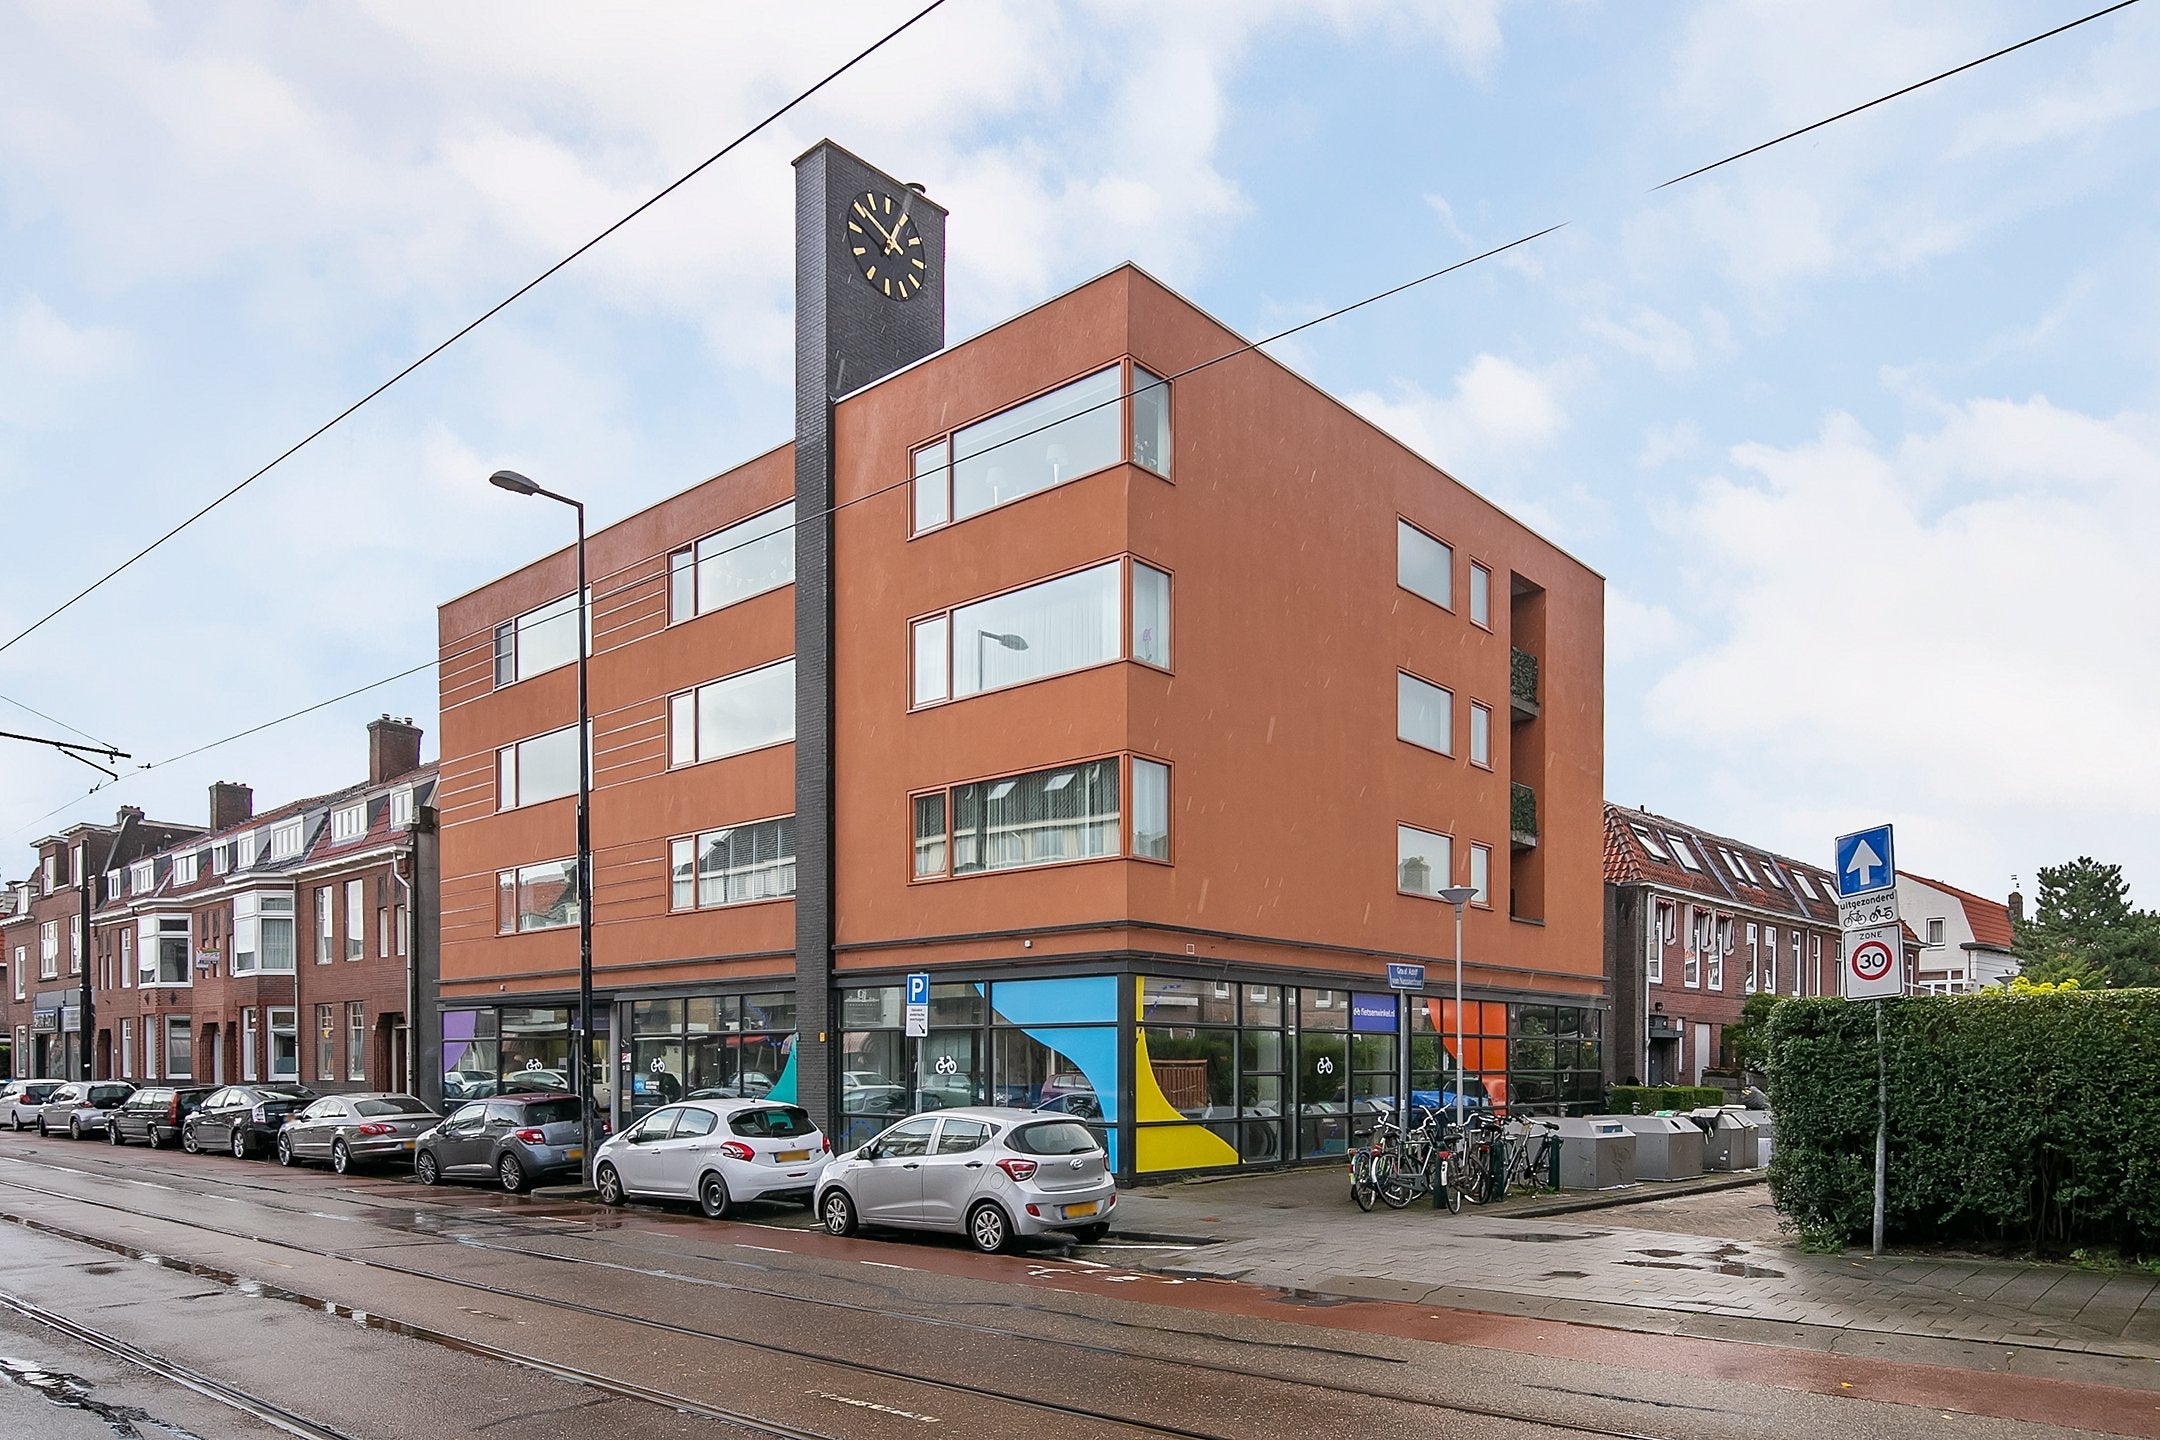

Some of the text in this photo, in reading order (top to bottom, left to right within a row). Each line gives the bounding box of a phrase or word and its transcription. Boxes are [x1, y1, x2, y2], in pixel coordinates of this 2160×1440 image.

[1840, 891, 1895, 911] uitgezonderd
[1859, 930, 1883, 941] ZONE
[1859, 952, 1885, 970] 30
[912, 978, 924, 1001] P
[1361, 1008, 1395, 1017] fietsenwinkel.nl
